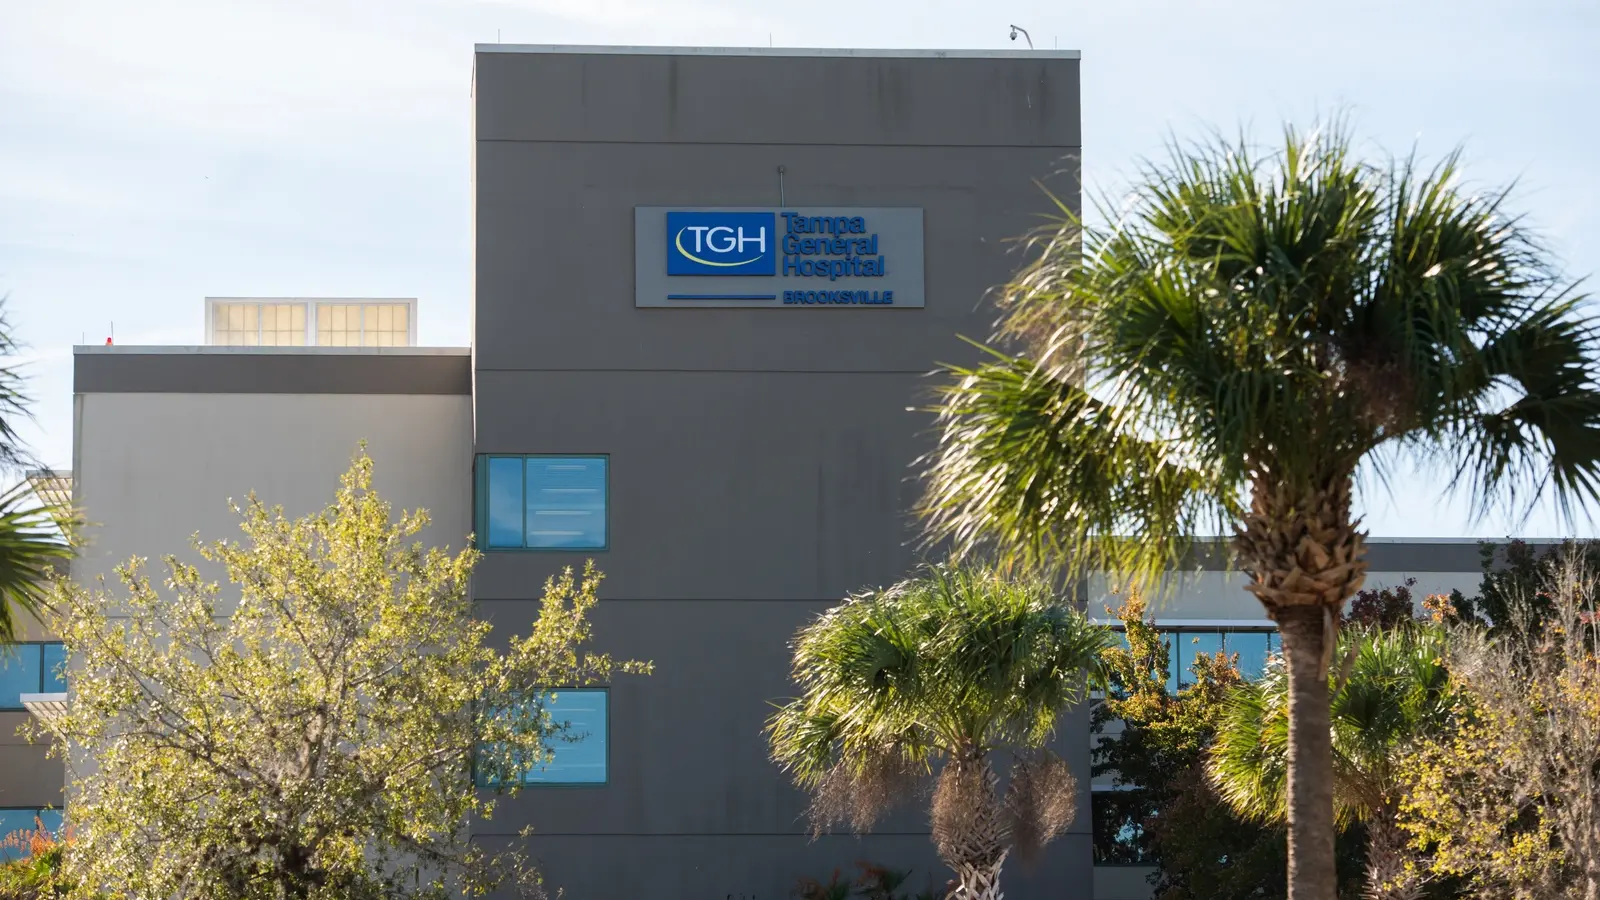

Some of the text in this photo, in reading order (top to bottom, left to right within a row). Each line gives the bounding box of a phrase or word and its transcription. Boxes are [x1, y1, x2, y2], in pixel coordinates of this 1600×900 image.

[781, 212, 865, 237] Tampa
[687, 226, 766, 253] TGH
[782, 234, 878, 255] General
[783, 256, 884, 281] Hospital
[783, 291, 893, 304] BROOKSVILLE
